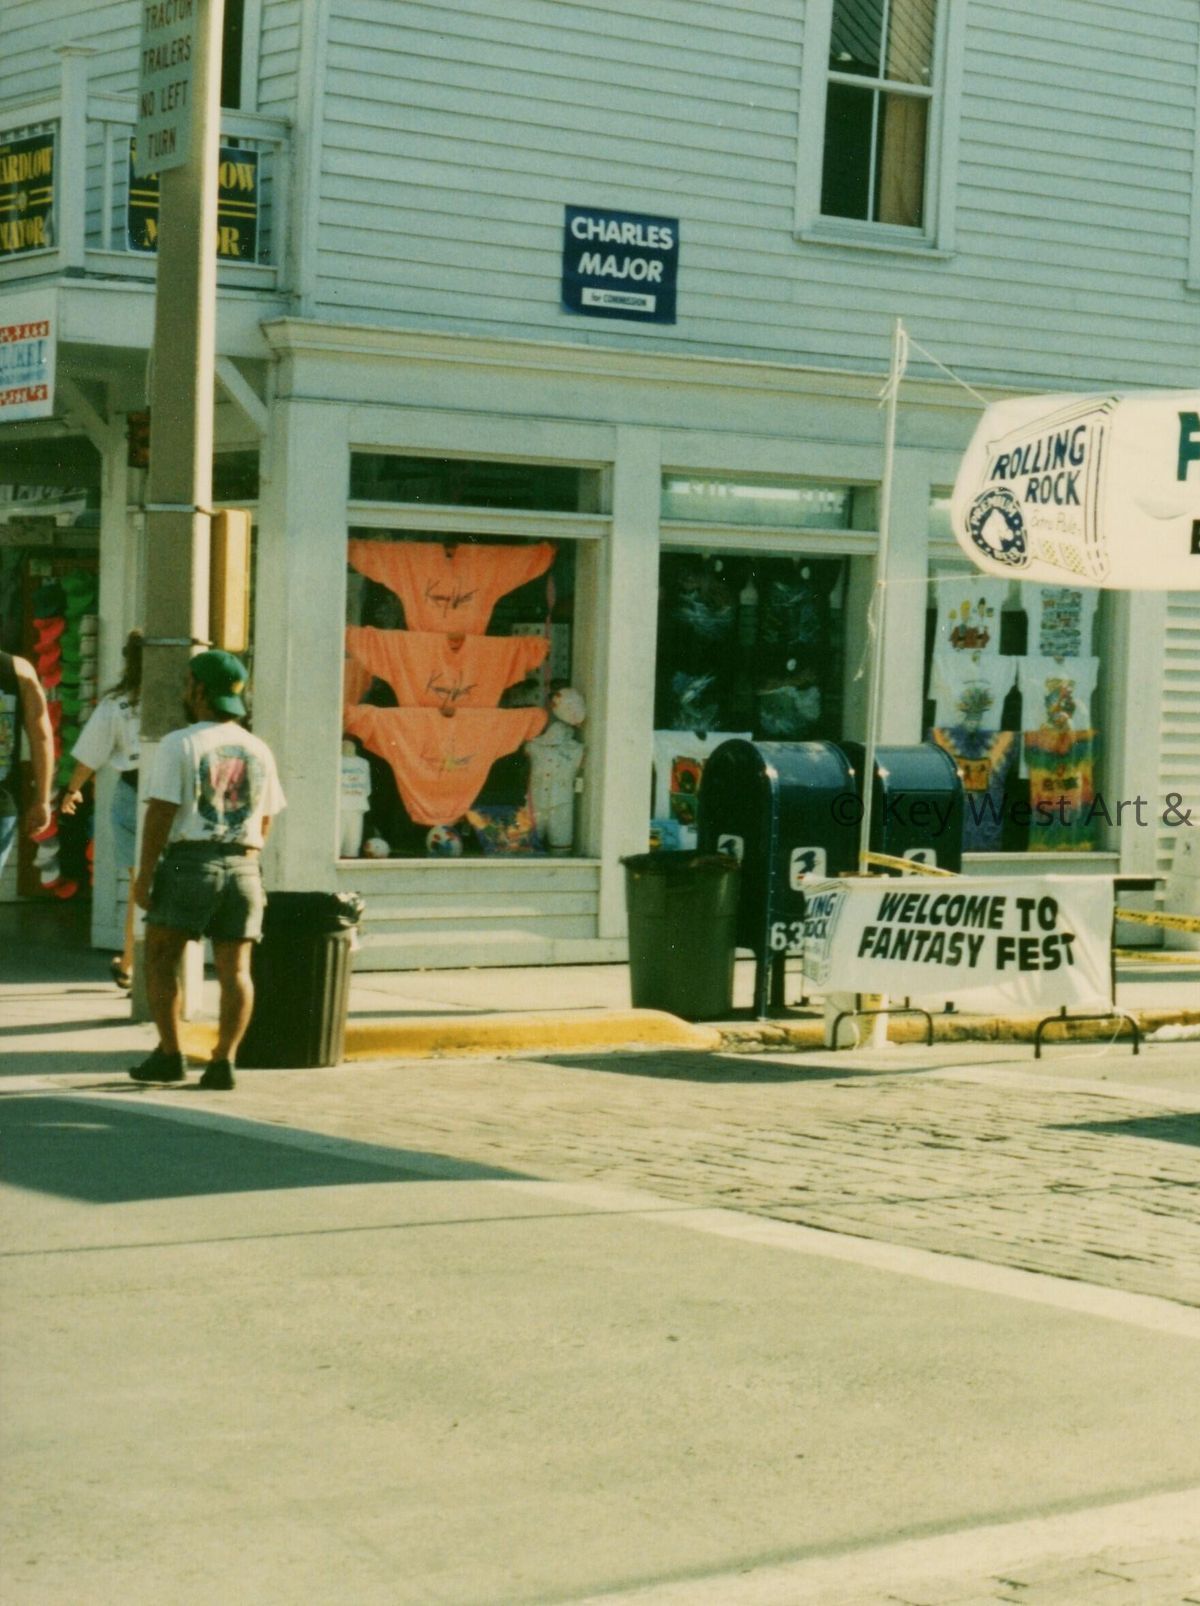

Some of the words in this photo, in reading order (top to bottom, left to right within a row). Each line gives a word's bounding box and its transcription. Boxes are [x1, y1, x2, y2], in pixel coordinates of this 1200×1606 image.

[144, 0, 192, 33] TRACTOR
[143, 35, 191, 76] TRAILERS
[141, 91, 155, 118] NO
[161, 80, 188, 112] LEFT
[149, 127, 176, 159] TURN
[0, 147, 53, 184] ARDLOW
[571, 216, 674, 250] CHARLES
[578, 251, 664, 283] MAJOR
[990, 425, 1087, 481] ROLLING
[1025, 469, 1081, 506] ROCK
[877, 892, 1005, 931] WELCOME
[1016, 896, 1059, 932] TO
[770, 921, 804, 951] 63
[858, 926, 985, 968] FANTASY
[996, 933, 1076, 972] FEST
